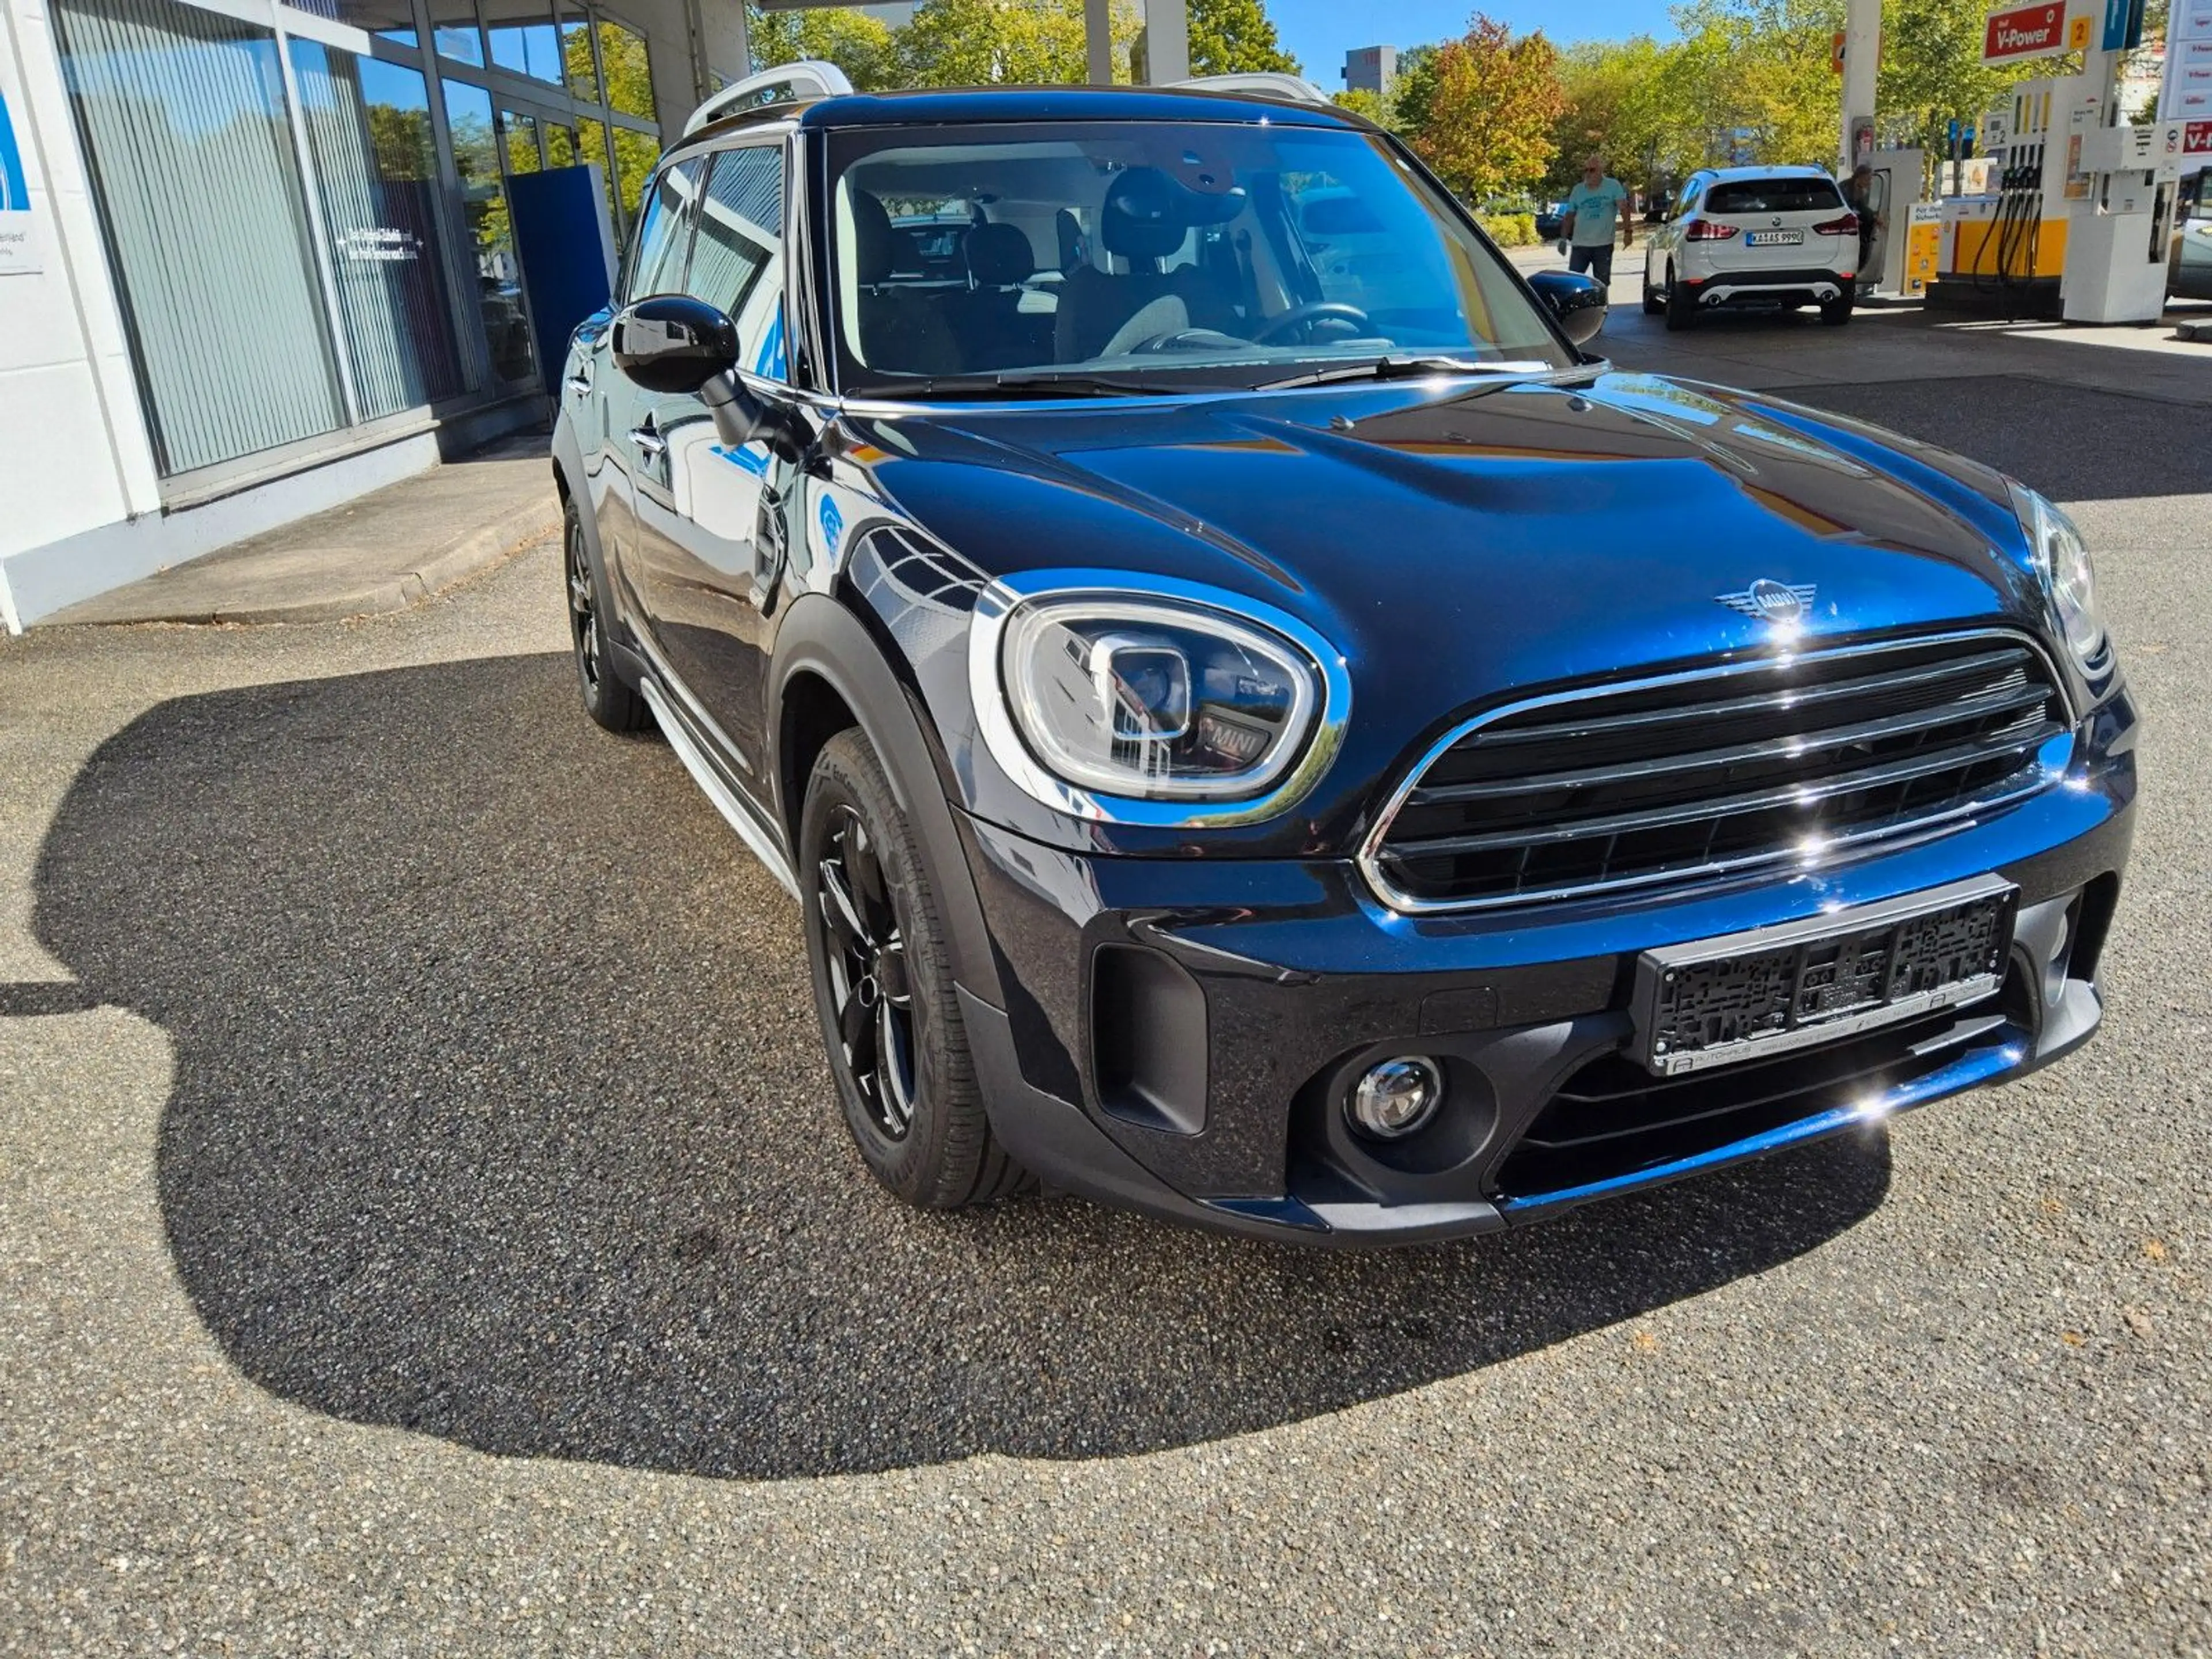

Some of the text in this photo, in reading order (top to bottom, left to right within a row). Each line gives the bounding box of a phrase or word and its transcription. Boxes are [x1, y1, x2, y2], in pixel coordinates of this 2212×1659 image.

[1997, 28, 2050, 49] V-Power
[2076, 23, 2084, 40] 2
[2000, 130, 2006, 143] 2
[1757, 593, 1796, 608] MINI
[1212, 725, 1257, 754] MINI
